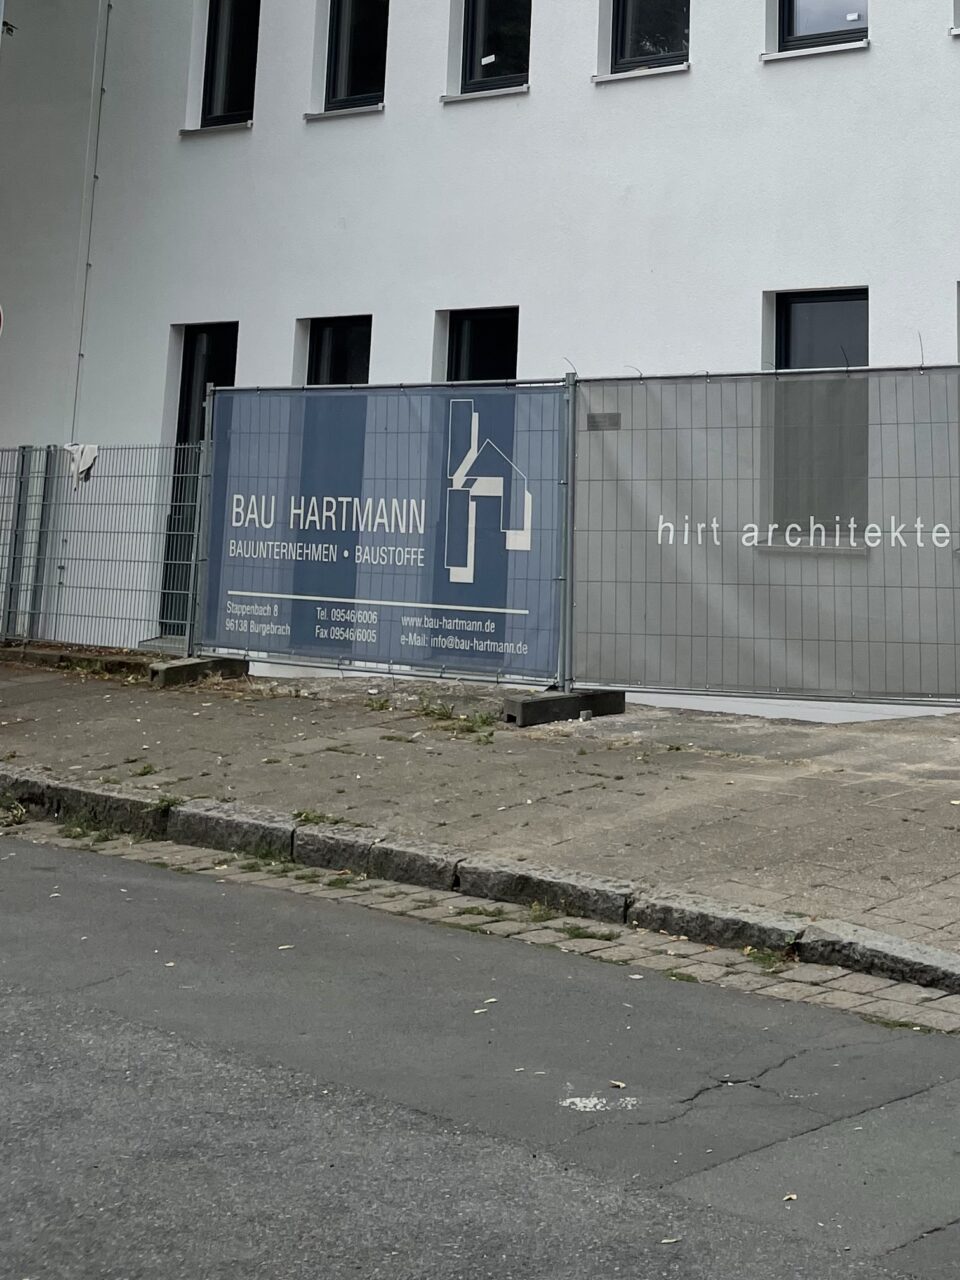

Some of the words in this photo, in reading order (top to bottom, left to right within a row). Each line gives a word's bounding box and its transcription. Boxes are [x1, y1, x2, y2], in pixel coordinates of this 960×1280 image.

[231, 494, 275, 529] BAU
[289, 495, 426, 534] HARTMANN
[657, 514, 721, 546] hirt
[229, 539, 338, 562] BAUUNTERNEHMEN
[355, 545, 425, 567] BAUSTOFFE
[226, 600, 272, 617] Stappenbach
[273, 604, 279, 617] 8
[316, 607, 329, 620] Tel.
[331, 608, 378, 624] 09546/6006
[225, 618, 248, 632] 96138
[249, 620, 291, 636] Burgebrach
[401, 614, 495, 633] www.bau-hartmann.de
[315, 625, 328, 639] Fax
[330, 626, 377, 642] 09546/6005
[400, 632, 428, 647] e-Mail:
[430, 634, 528, 655] info@bau-hartmann.de
